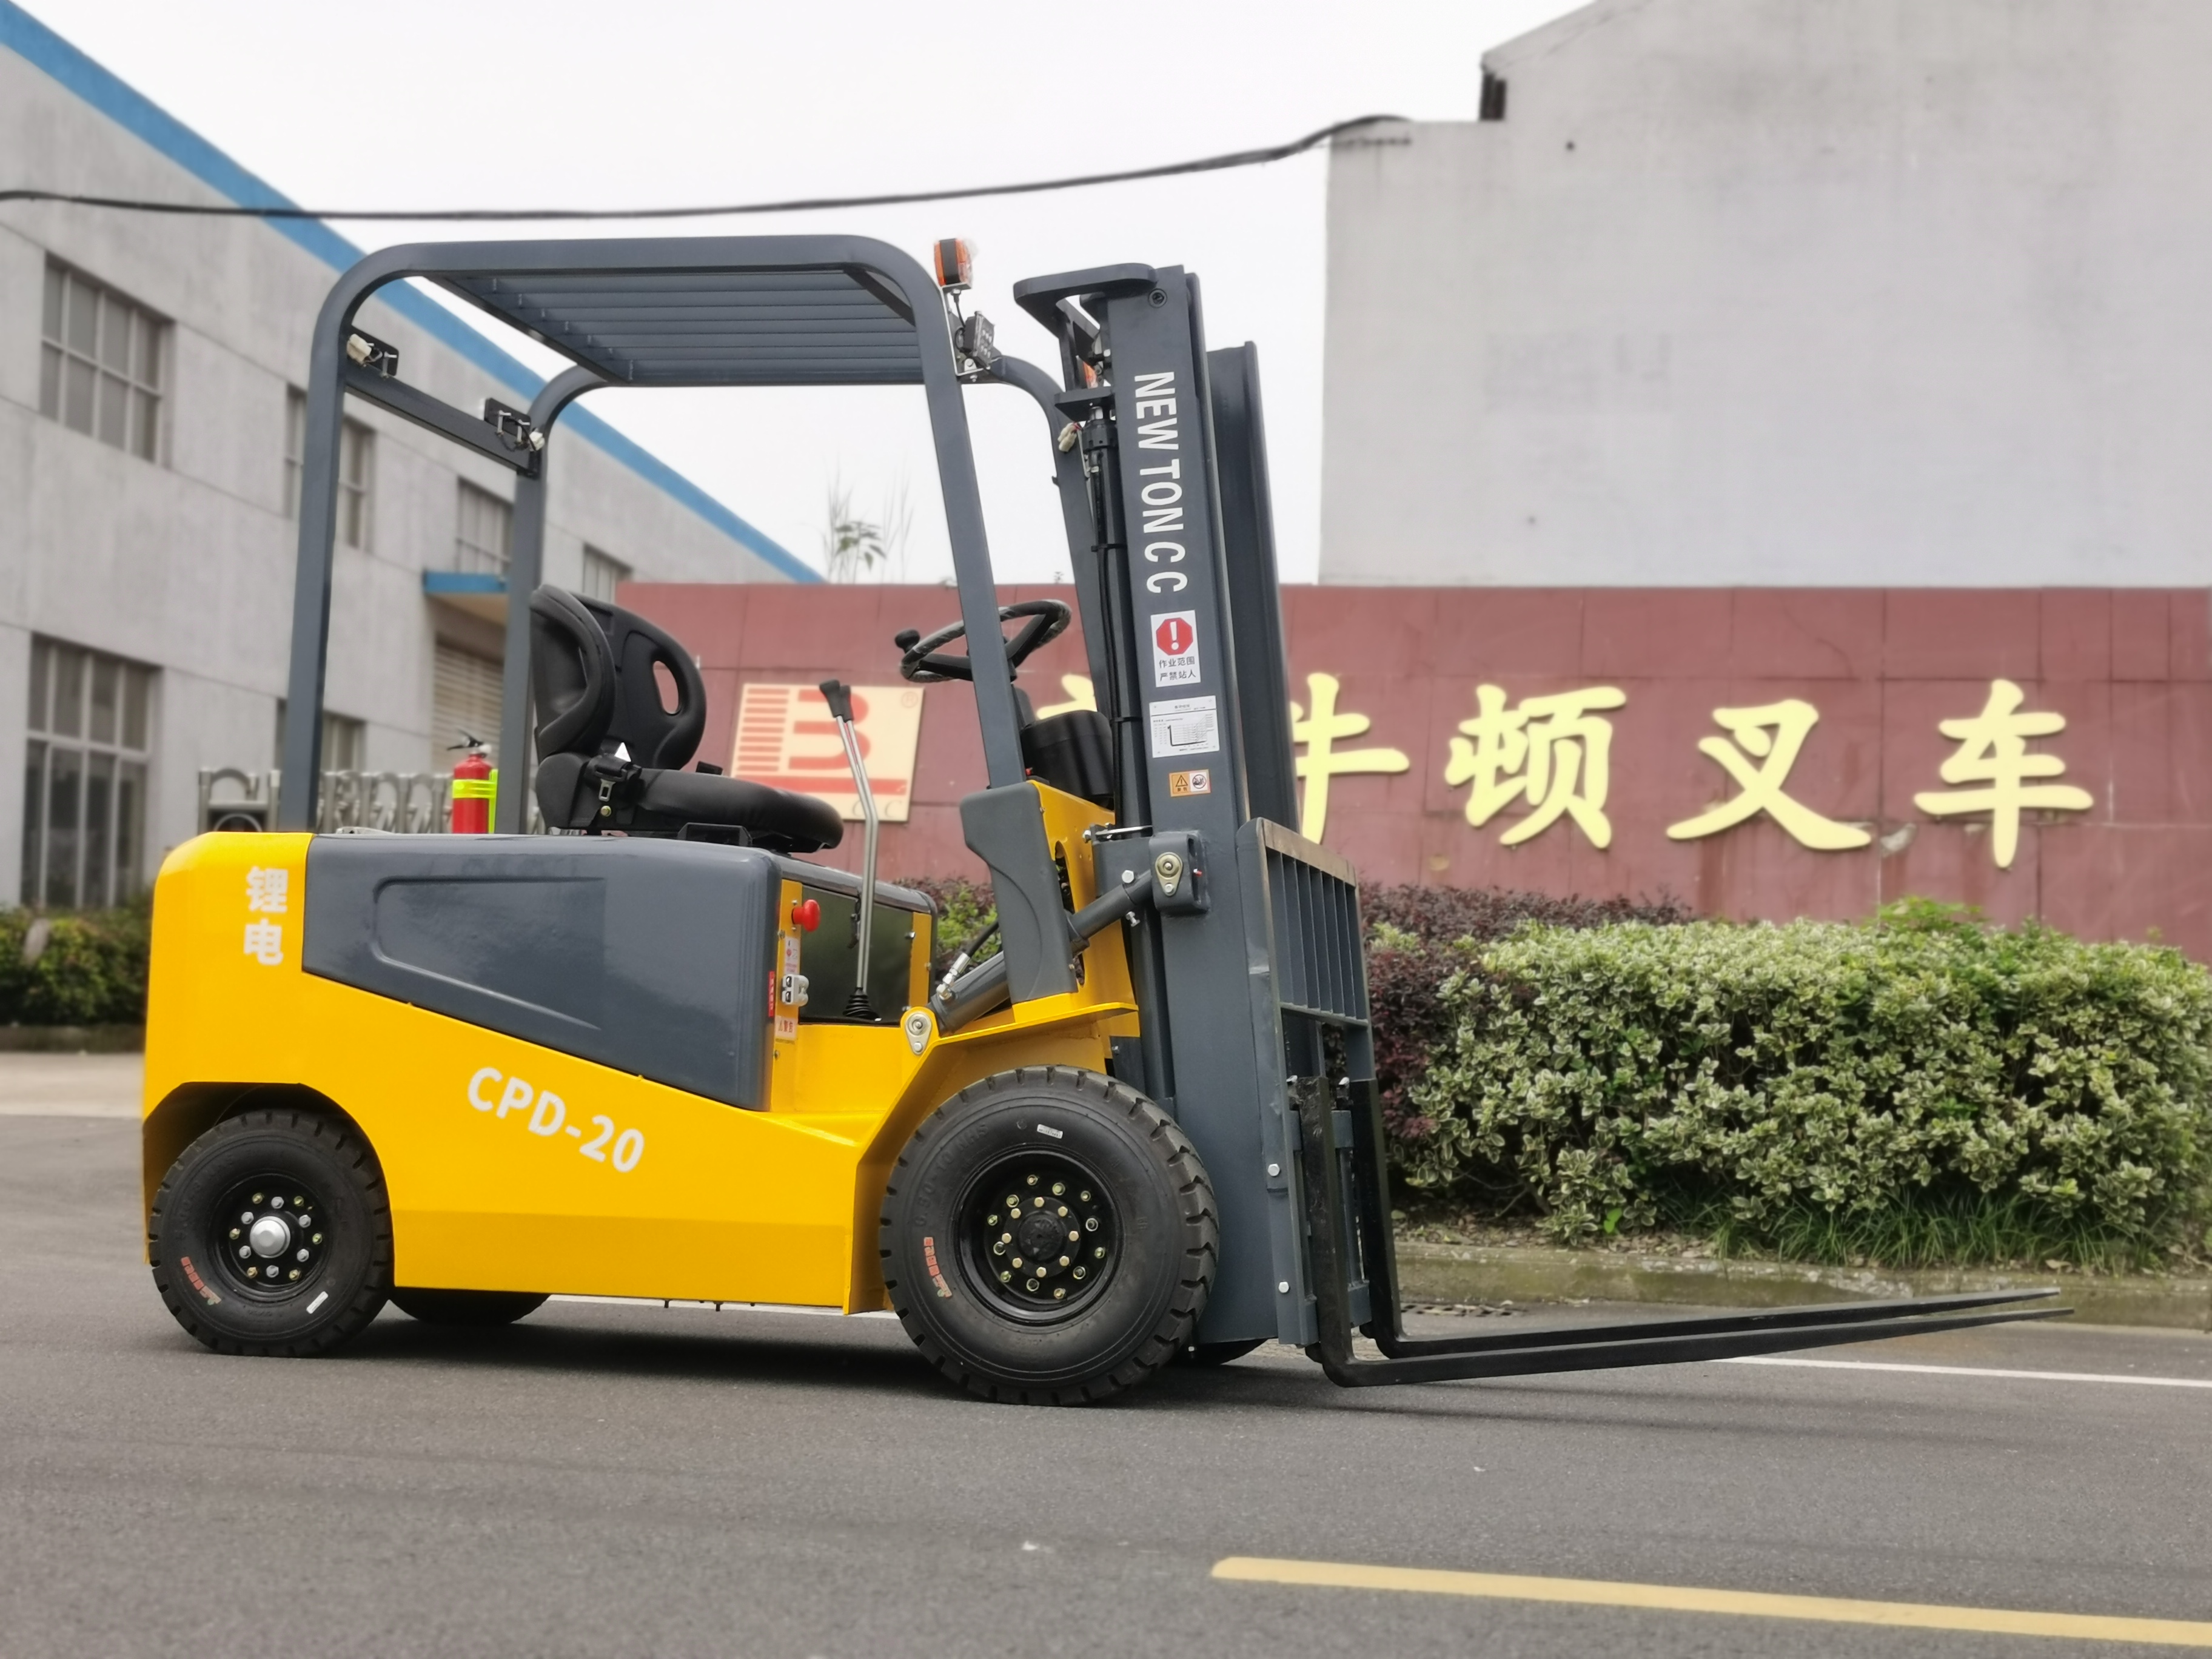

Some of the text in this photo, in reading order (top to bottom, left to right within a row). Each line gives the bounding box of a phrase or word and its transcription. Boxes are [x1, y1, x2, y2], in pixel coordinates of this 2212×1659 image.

[1159, 656, 1195, 669] 作业范围
[1160, 669, 1196, 682] 严禁站人
[243, 866, 289, 966] 锂电
[468, 1067, 646, 1174] CPD-20
